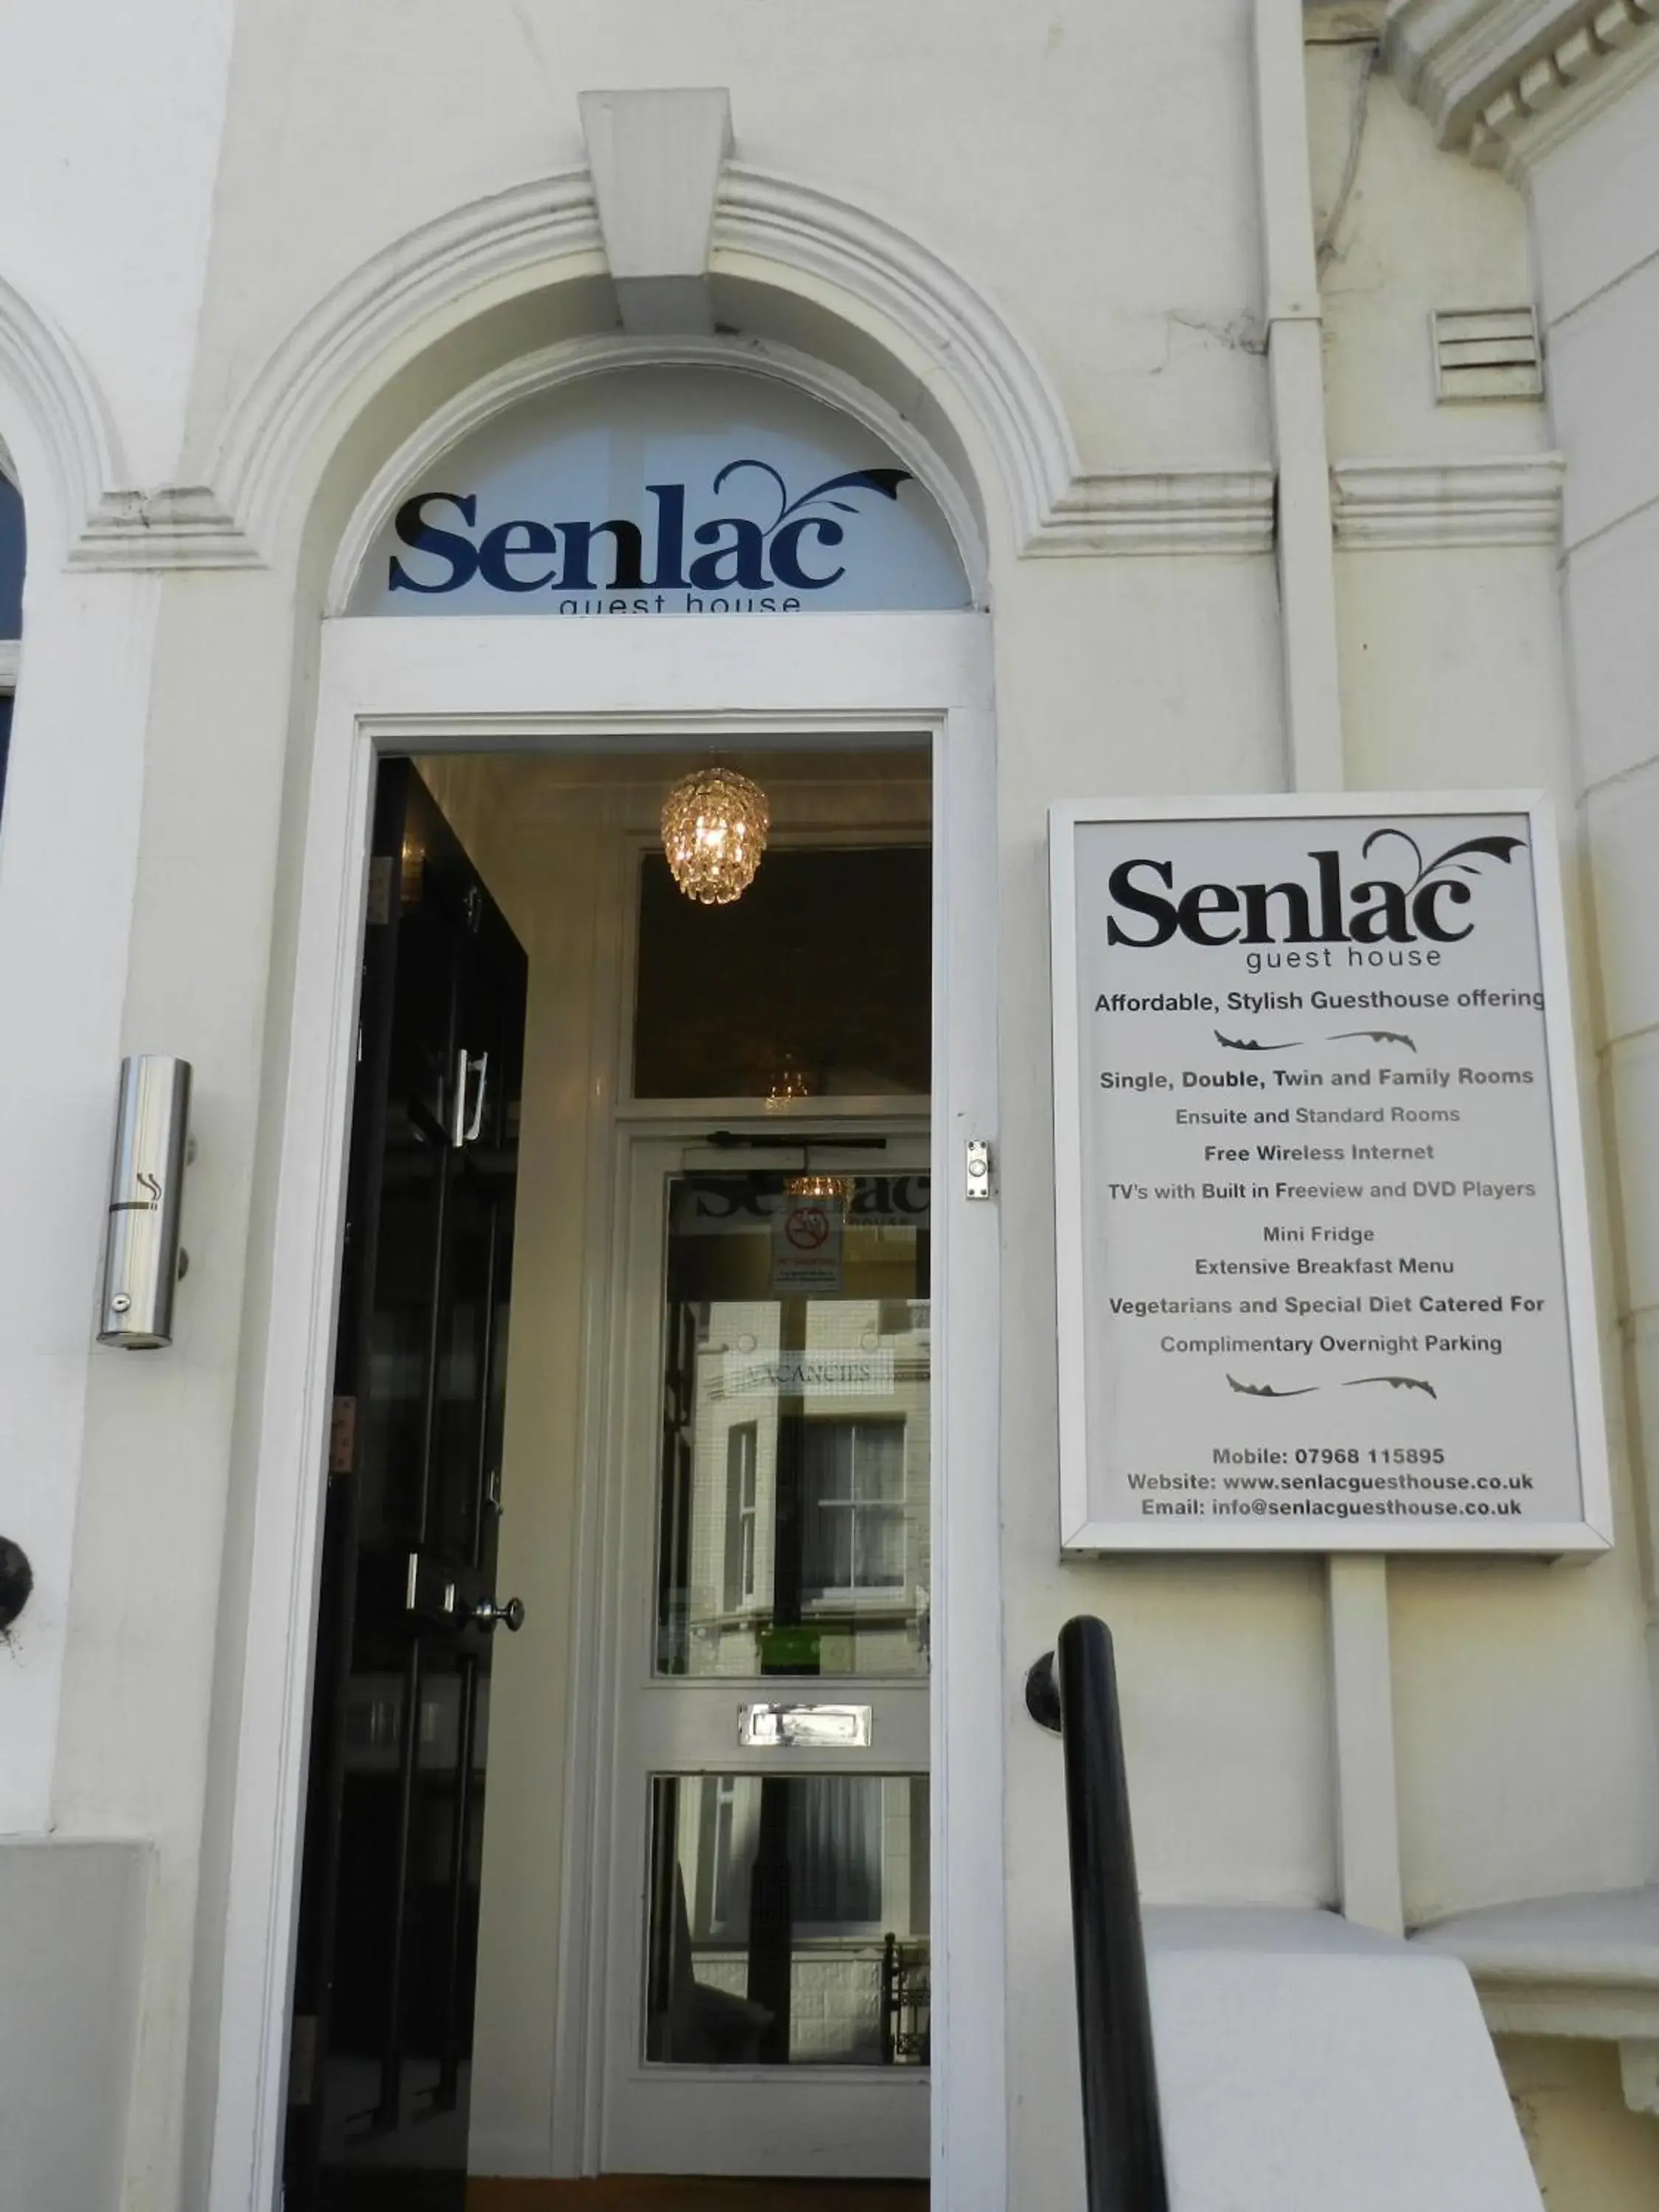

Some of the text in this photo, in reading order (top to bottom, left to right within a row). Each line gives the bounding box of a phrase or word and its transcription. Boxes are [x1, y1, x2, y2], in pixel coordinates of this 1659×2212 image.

[389, 484, 846, 594] Senlac
[1106, 850, 1475, 948] Senlac
[1246, 946, 1442, 973] guest house
[1094, 989, 1545, 1014] Affordable, Stylish Guesthouse offering
[1100, 1067, 1534, 1092] Single, Double, Twin and Family Rooms
[1176, 1106, 1461, 1124] Ensuite and Standard Rooms
[1204, 1144, 1435, 1161] Free Wireless Internet
[1107, 1180, 1537, 1200] TV's with Built in Freeview and DVD Players
[1263, 1226, 1375, 1246] Mini Fridge
[1195, 1257, 1454, 1275] Extensive Breakfast Menu
[1108, 1295, 1545, 1318] Vegetarians and Special Diet Catered For
[1161, 1335, 1502, 1356] Complimentary Overnight Parking
[1213, 1447, 1445, 1464] Mobile: 07968 115895
[1127, 1472, 1534, 1493] Website: www.senlacguesthouse.co.uk
[1141, 1498, 1523, 1519] Email: info@senlacguesthouse.co.uk
